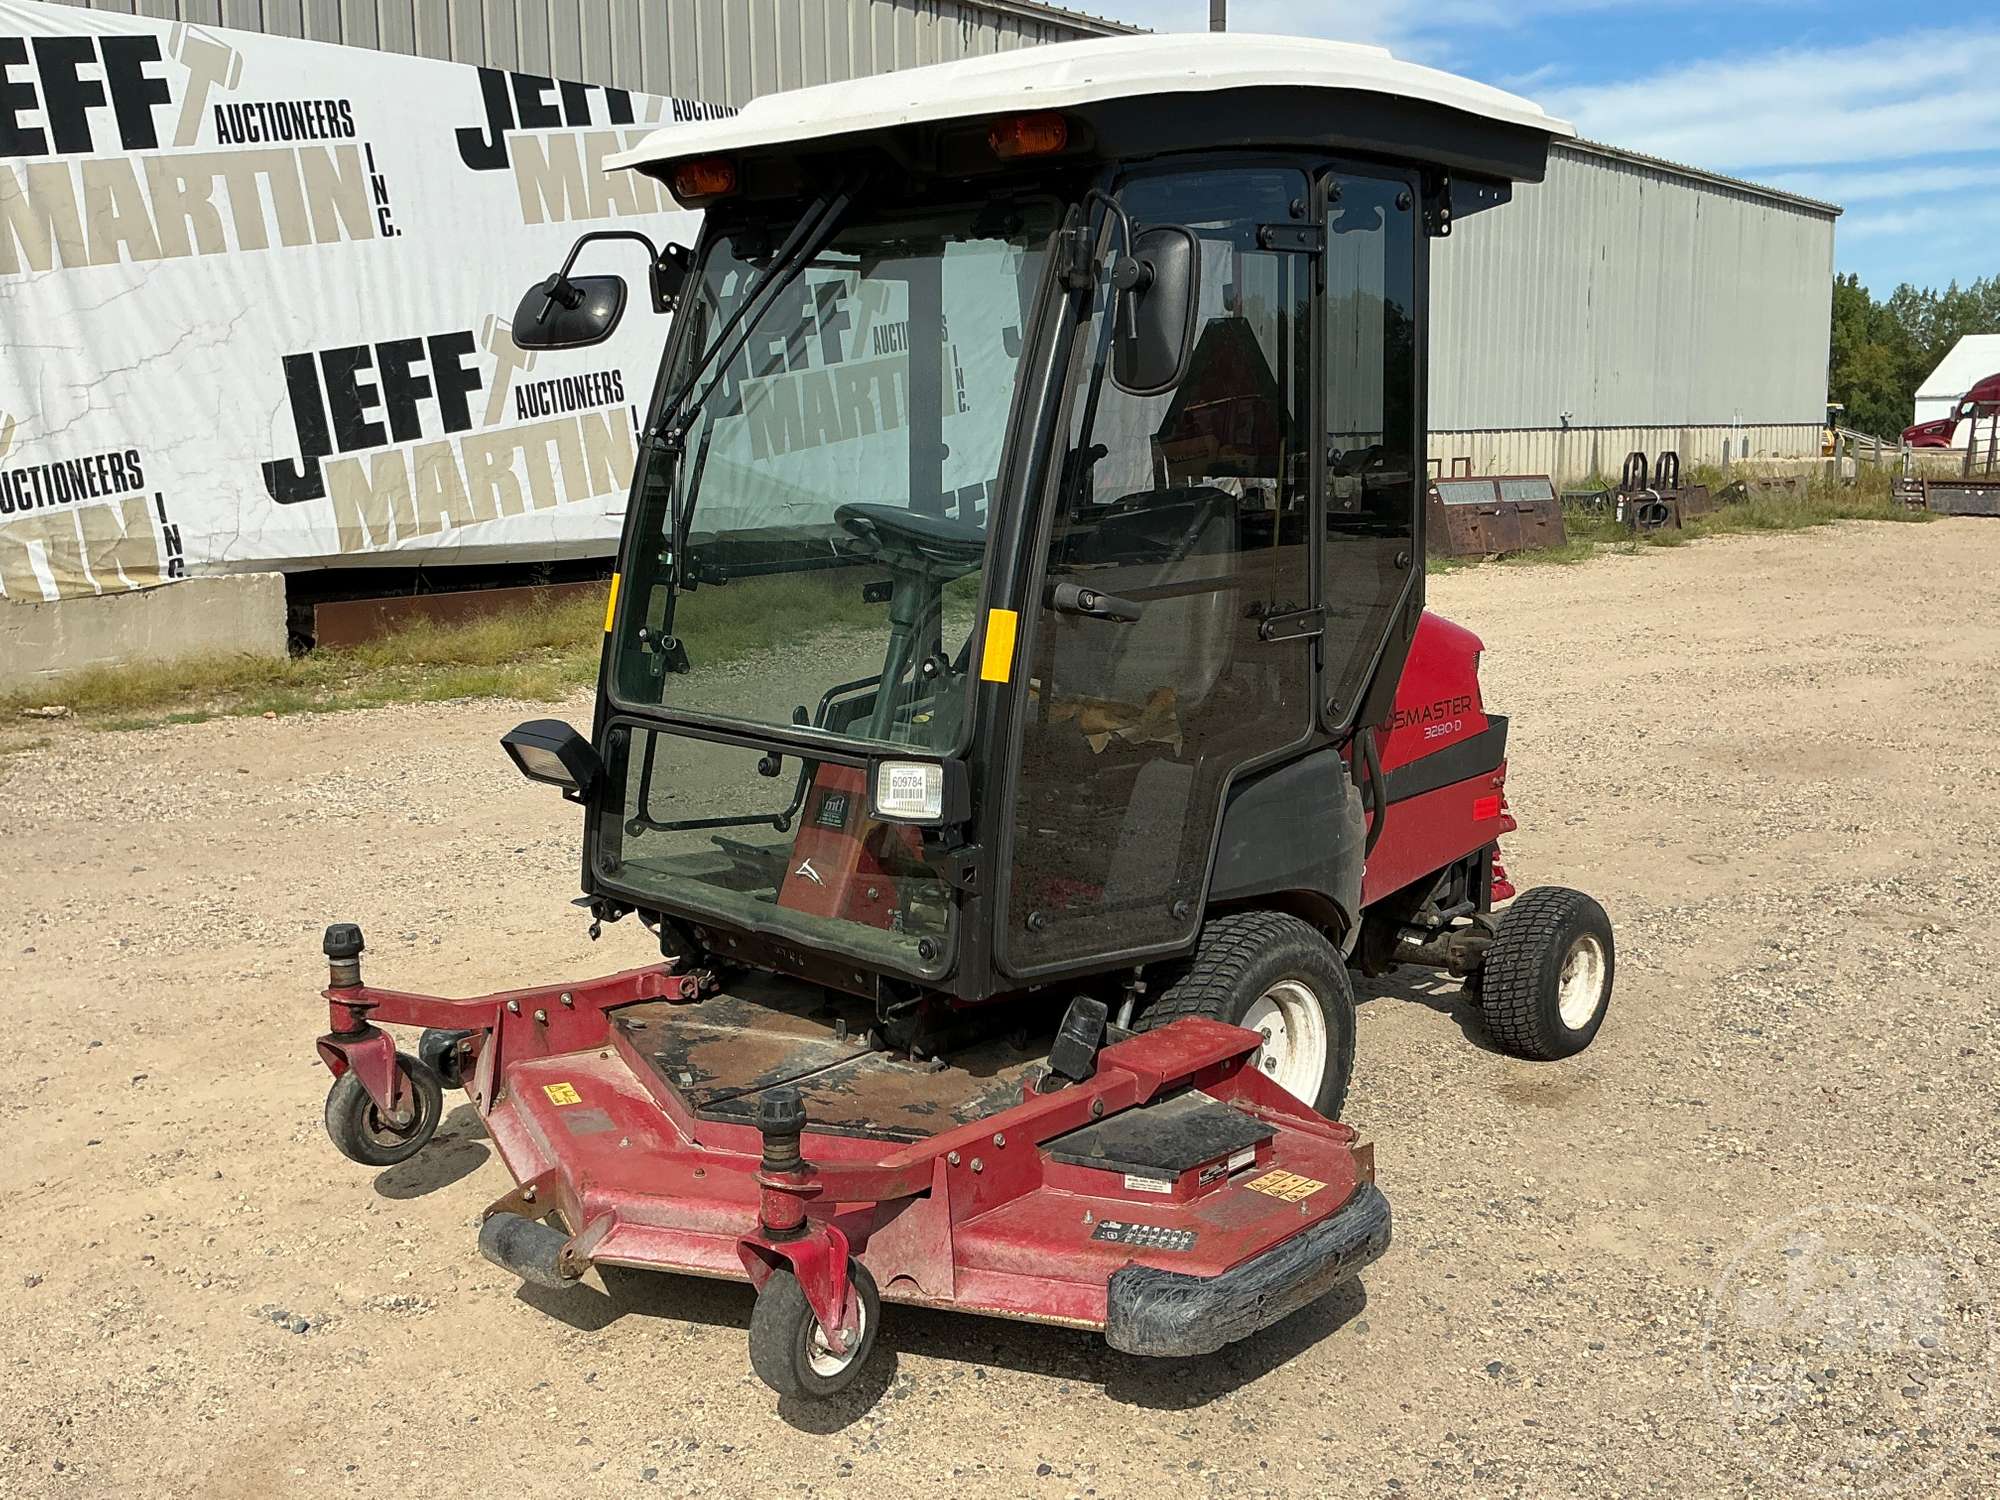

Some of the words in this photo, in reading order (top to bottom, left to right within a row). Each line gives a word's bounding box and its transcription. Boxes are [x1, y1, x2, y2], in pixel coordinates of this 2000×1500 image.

[0, 35, 172, 157] EFF
[214, 99, 356, 145] AUCTIONEERS
[261, 330, 483, 505] JEFF
[515, 369, 625, 421] AUCTIONEERS
[0, 449, 145, 514] UCTIONEERS
[325, 407, 637, 553] MARTIN
[892, 775, 922, 788] 609784
